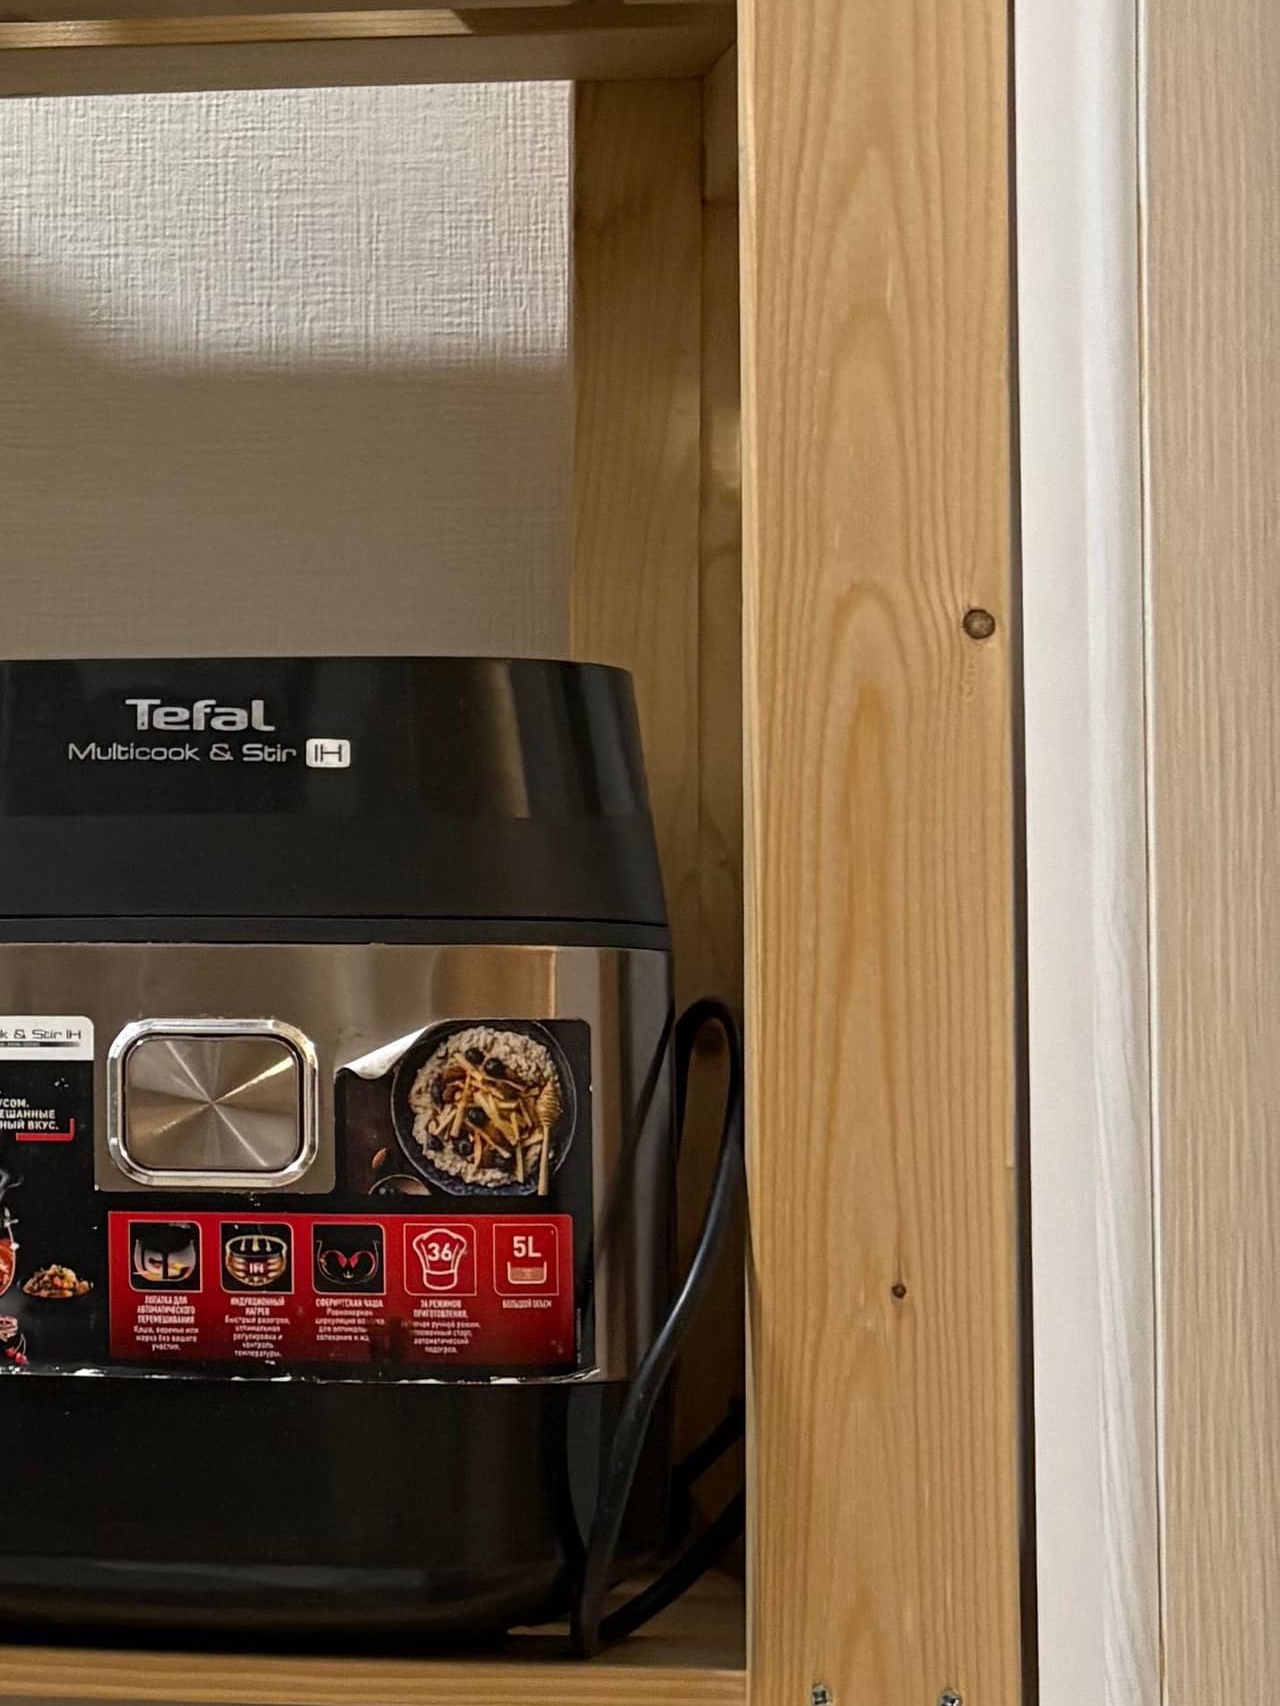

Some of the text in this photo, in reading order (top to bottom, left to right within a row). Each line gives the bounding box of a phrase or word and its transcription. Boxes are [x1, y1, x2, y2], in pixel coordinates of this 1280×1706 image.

[125, 698, 276, 732] Tefal
[68, 742, 200, 761] Multicook
[209, 743, 233, 761] &
[242, 743, 297, 762] Stir
[14, 1029, 27, 1040] &
[32, 1029, 62, 1040] Stir
[66, 1029, 82, 1041] IH
[28, 1120, 59, 1131] ВКУС.
[427, 1242, 452, 1261] 36
[513, 1235, 542, 1258] 5L
